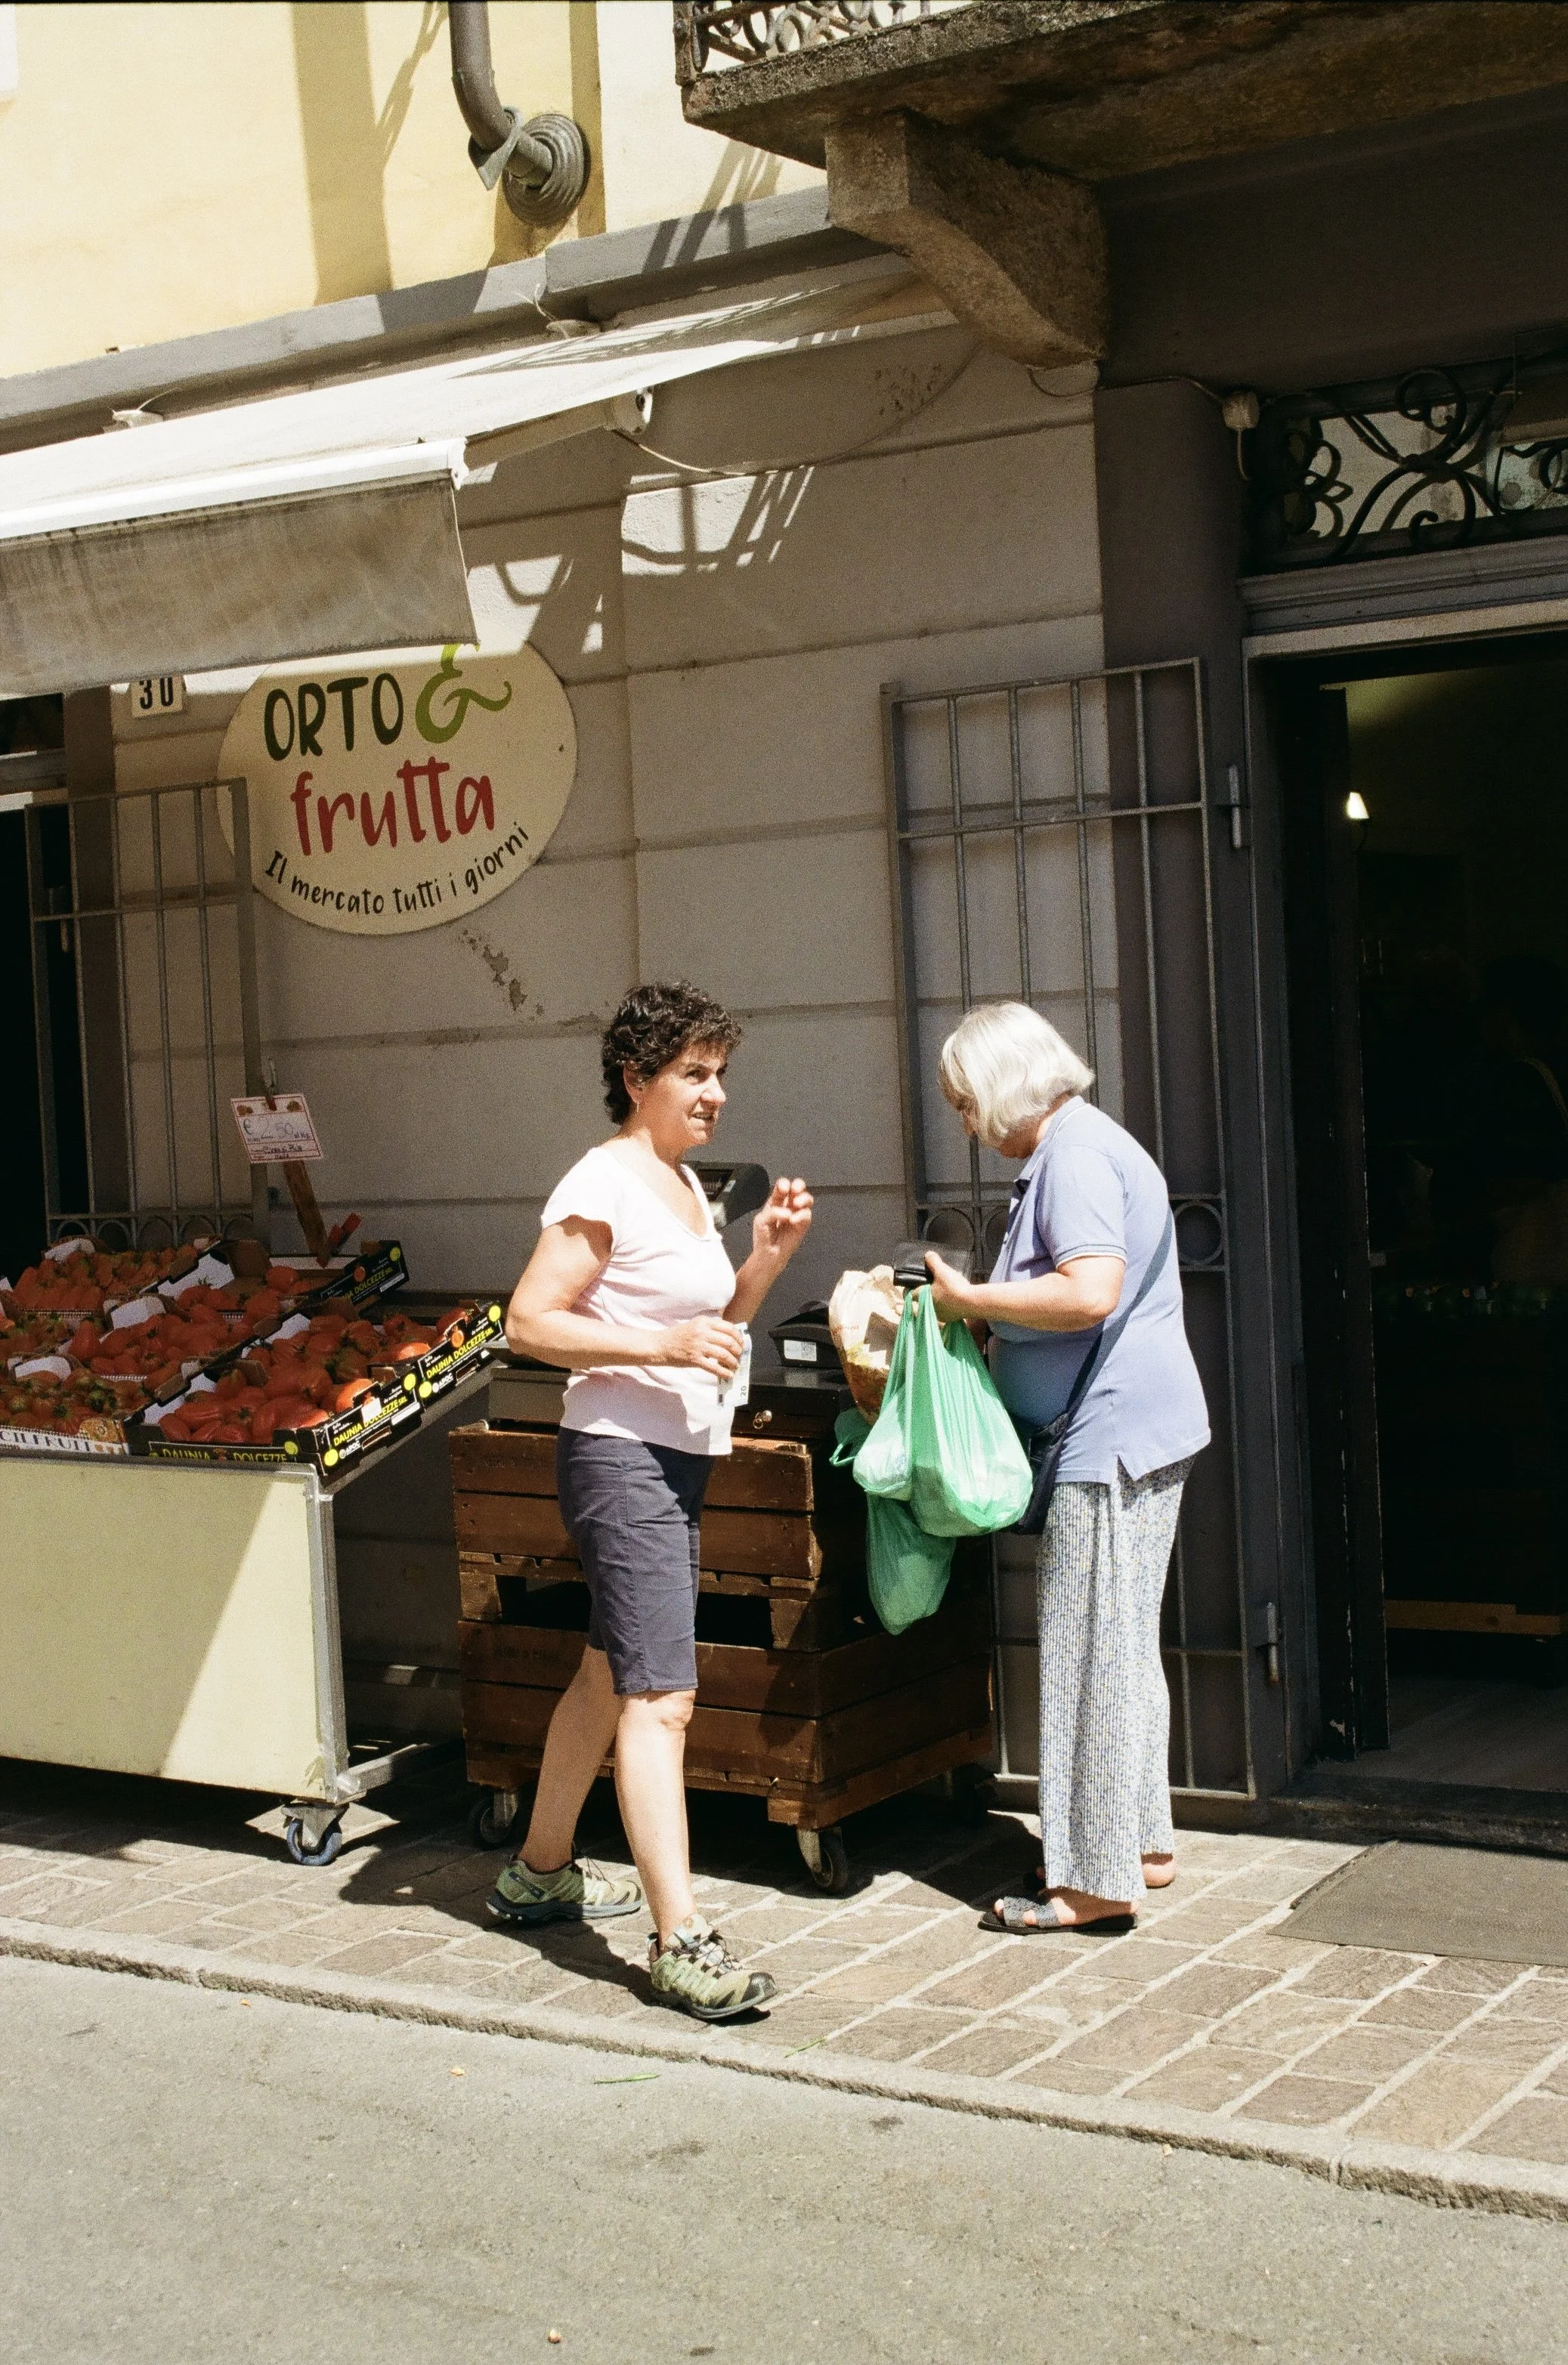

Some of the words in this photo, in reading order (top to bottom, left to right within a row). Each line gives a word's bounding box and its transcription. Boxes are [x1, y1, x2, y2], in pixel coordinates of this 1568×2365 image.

[139, 677, 174, 710] 30
[263, 672, 404, 761] ORTO
[415, 642, 513, 744] &
[289, 756, 495, 856] frutta
[265, 850, 288, 884] Il
[291, 875, 385, 915] mercato
[392, 878, 442, 914] tutti
[449, 872, 457, 897] i
[465, 821, 529, 895] giorni
[354, 1270, 385, 1293] DOLCEZZE
[426, 1355, 454, 1379] DAUNIA
[453, 1331, 485, 1360] DOLCEZZE
[333, 1423, 363, 1446] DAUNIA
